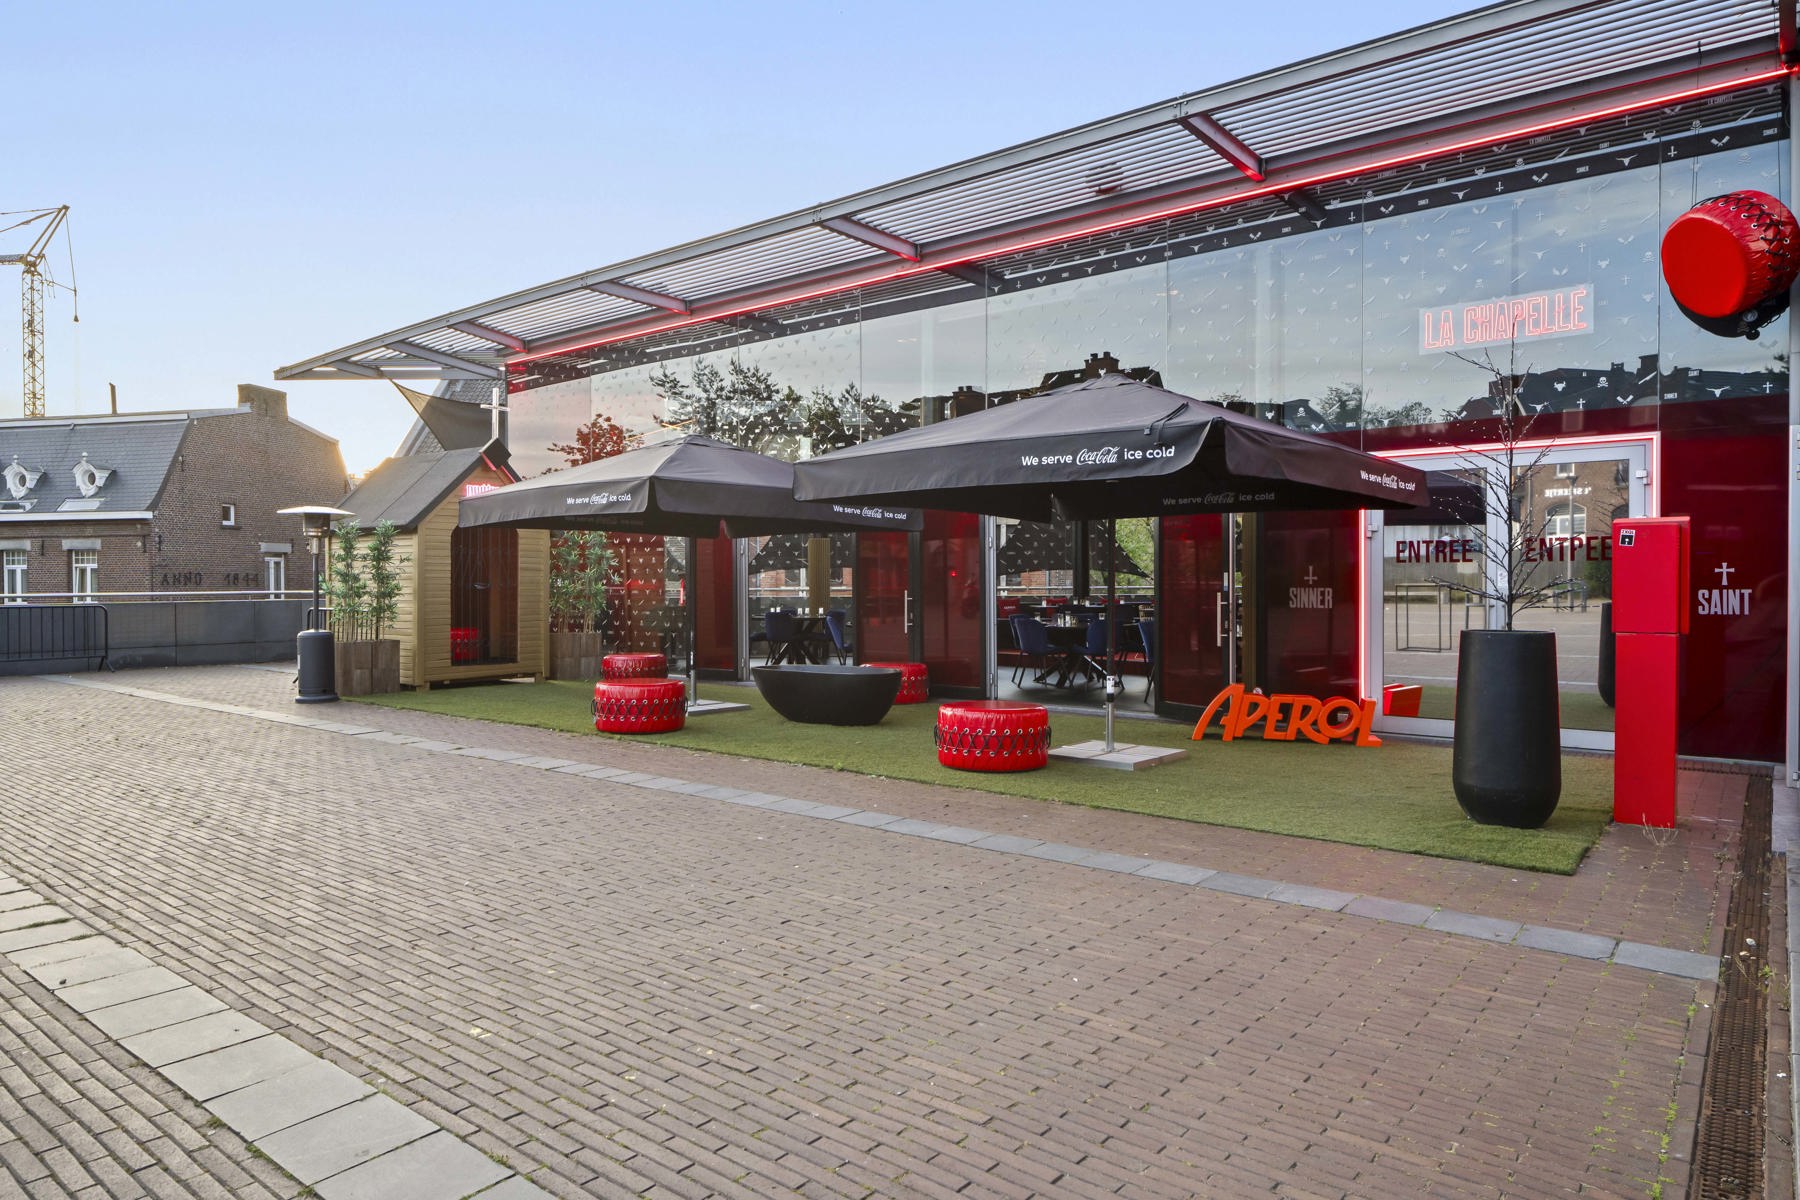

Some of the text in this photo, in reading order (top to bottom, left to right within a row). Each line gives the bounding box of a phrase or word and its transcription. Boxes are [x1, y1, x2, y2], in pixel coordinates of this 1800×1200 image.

[1424, 287, 1588, 349] LA CHAPELLE
[1021, 455, 1039, 466] We
[1041, 454, 1073, 465] serve
[1124, 448, 1143, 460] ice
[1146, 445, 1175, 459] cold
[1360, 470, 1369, 480] We
[1369, 473, 1382, 484] serve
[1405, 482, 1416, 491] cold
[566, 497, 575, 505] We
[618, 493, 632, 502] cold
[1162, 497, 1176, 505] We
[1178, 496, 1202, 505] serve
[1239, 493, 1253, 501] ice
[1254, 492, 1275, 501] cold
[832, 505, 844, 513] We
[844, 507, 861, 515] serve
[1396, 539, 1473, 563] ENTREE
[161, 571, 203, 586] ANNO
[1289, 587, 1333, 609] SINNER
[1697, 588, 1753, 616] SAINT
[1191, 683, 1383, 748] APEROL
